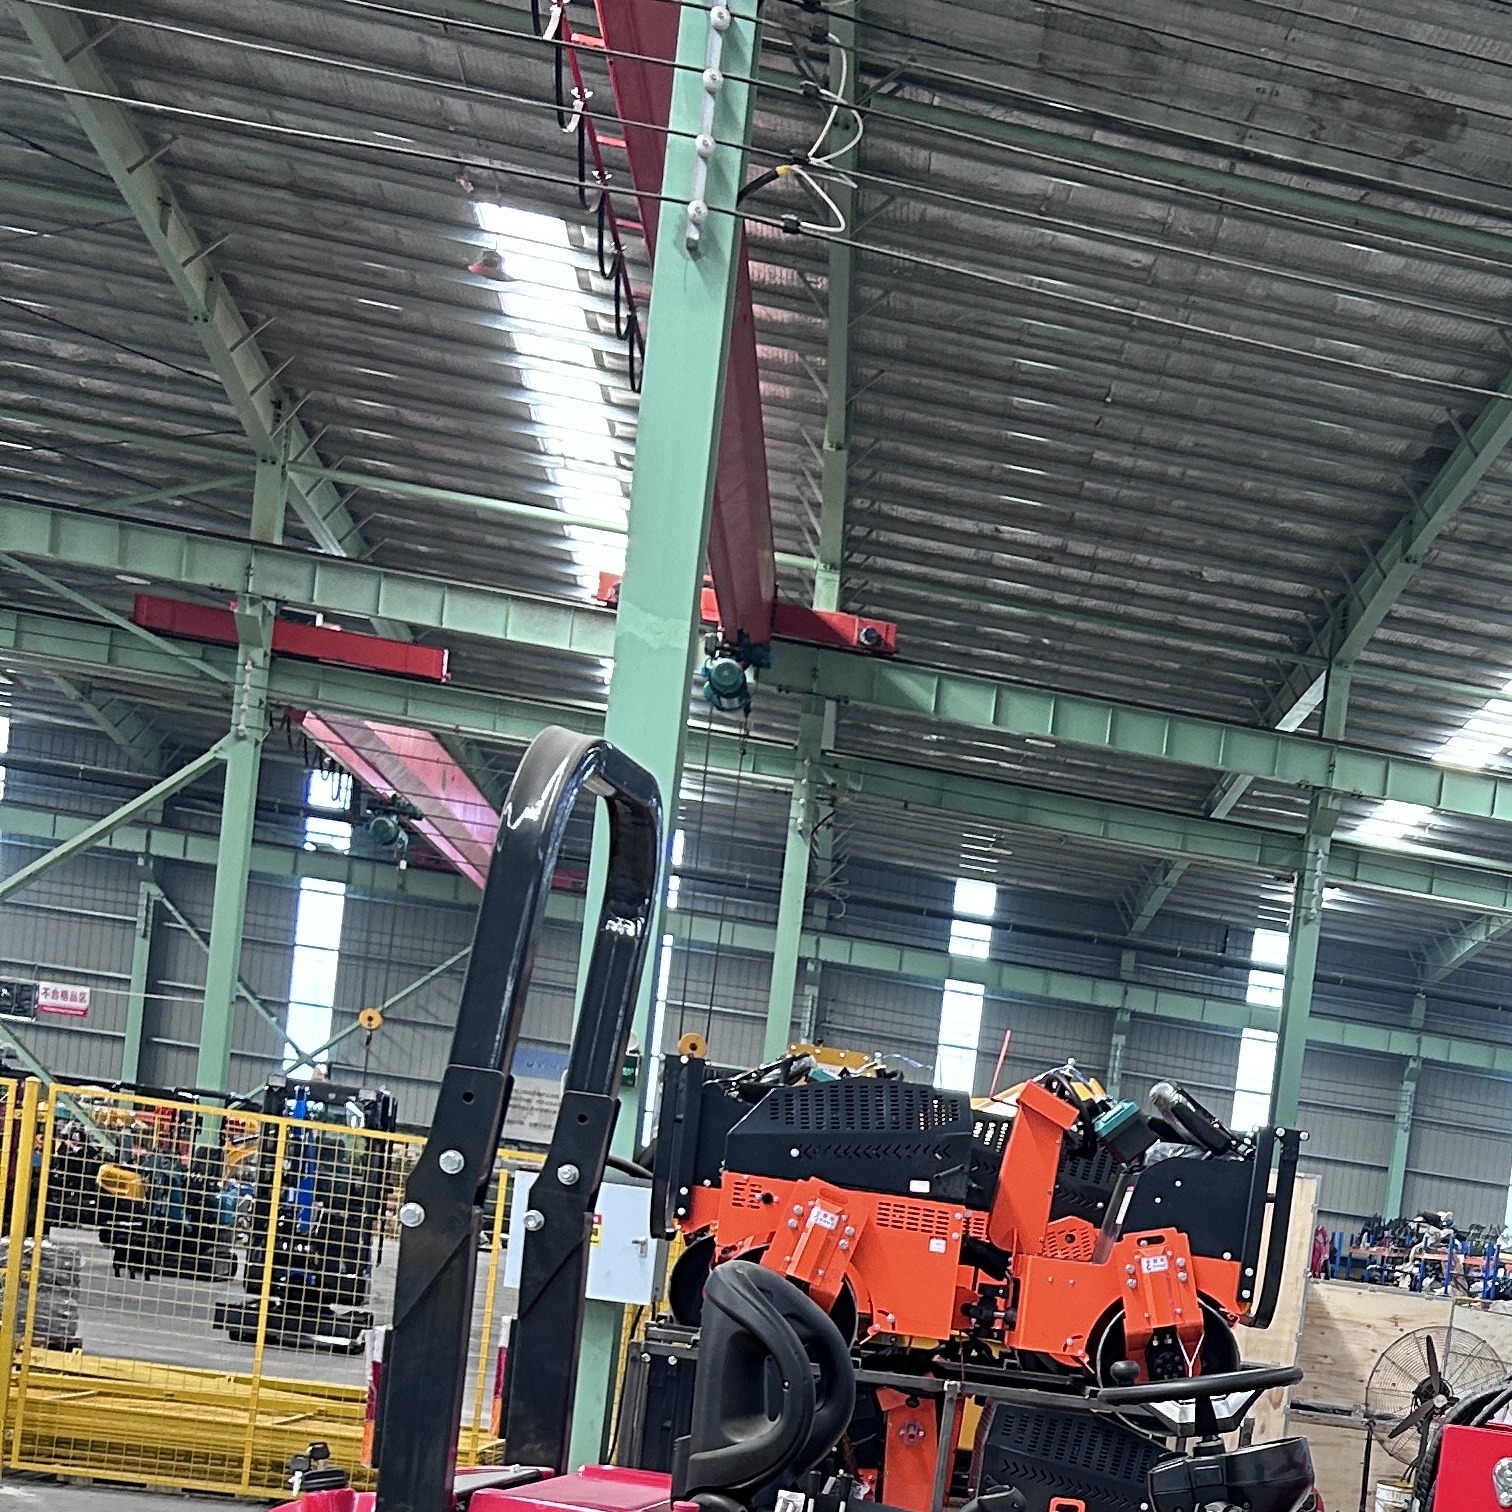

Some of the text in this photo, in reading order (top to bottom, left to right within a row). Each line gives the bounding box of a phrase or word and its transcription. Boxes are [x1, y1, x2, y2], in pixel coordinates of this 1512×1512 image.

[40, 986, 87, 1003] 不合格品区
